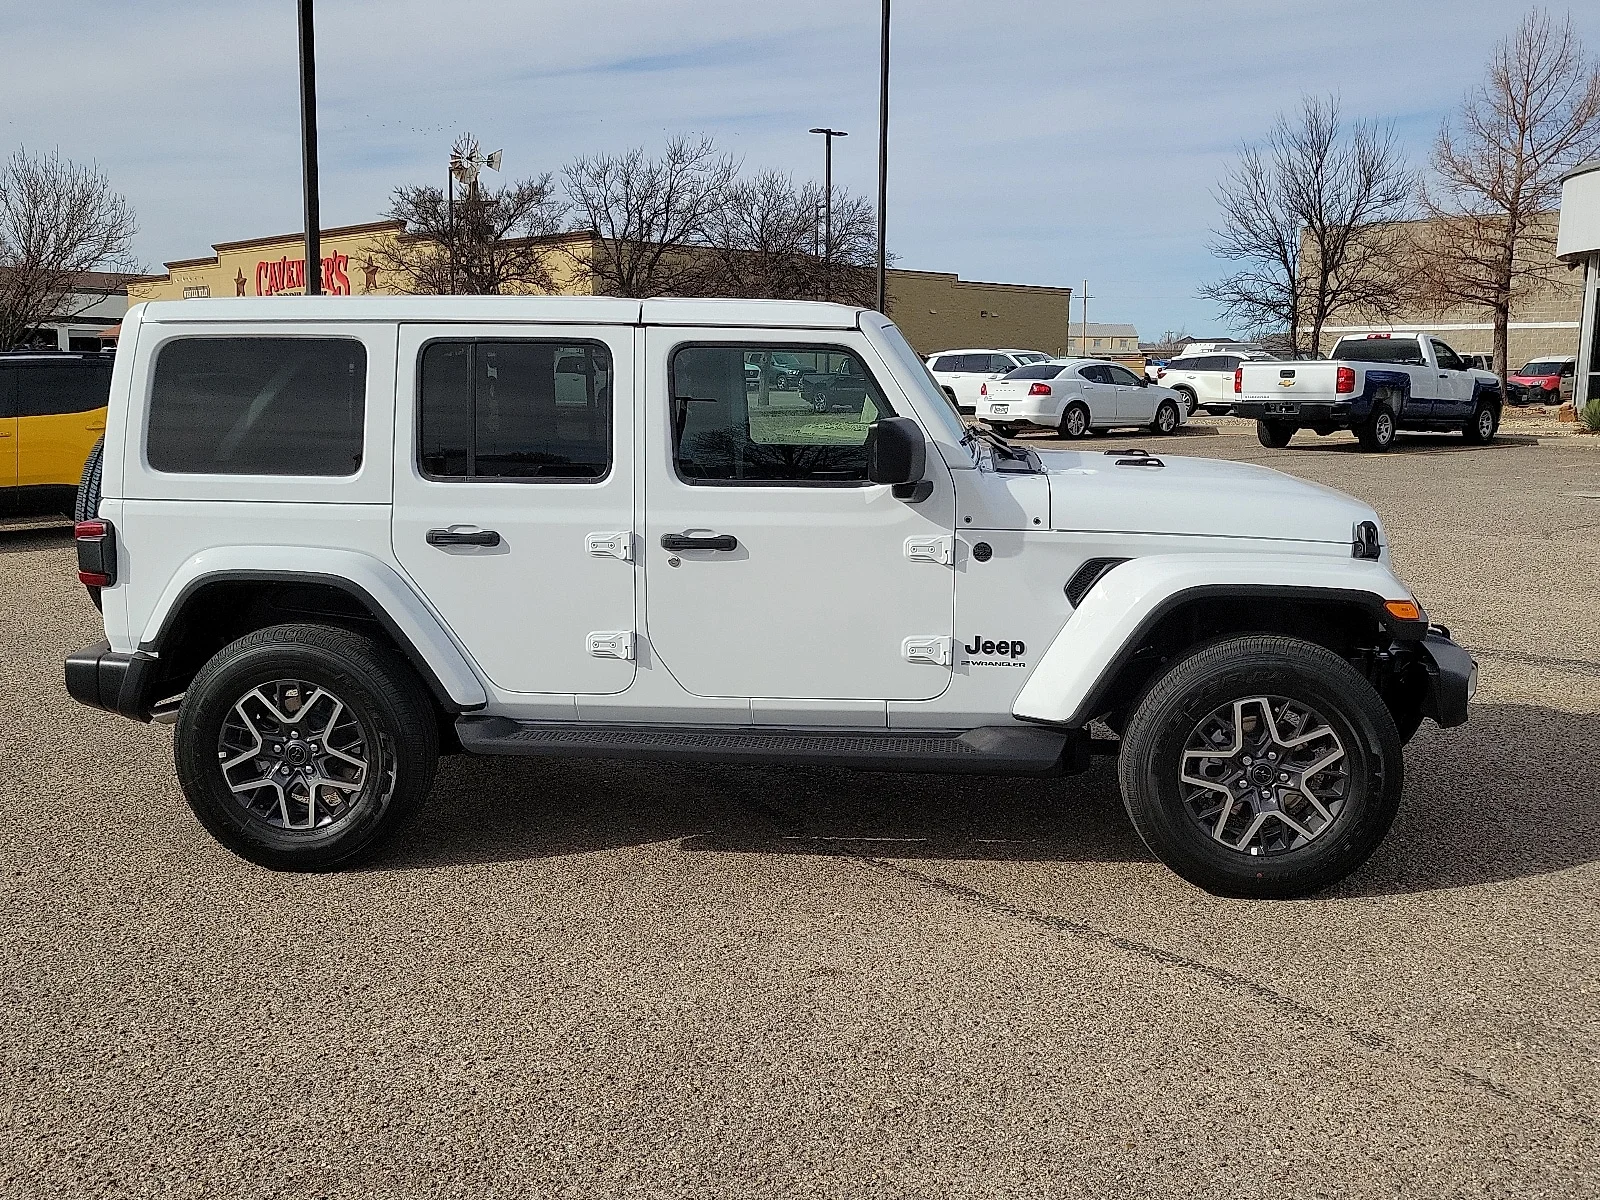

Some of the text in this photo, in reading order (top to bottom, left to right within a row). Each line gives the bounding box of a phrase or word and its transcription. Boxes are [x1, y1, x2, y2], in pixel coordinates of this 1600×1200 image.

[256, 250, 351, 296] CAVENR'S
[964, 635, 1026, 659] Jeep
[970, 660, 1026, 668] WRANGLER
